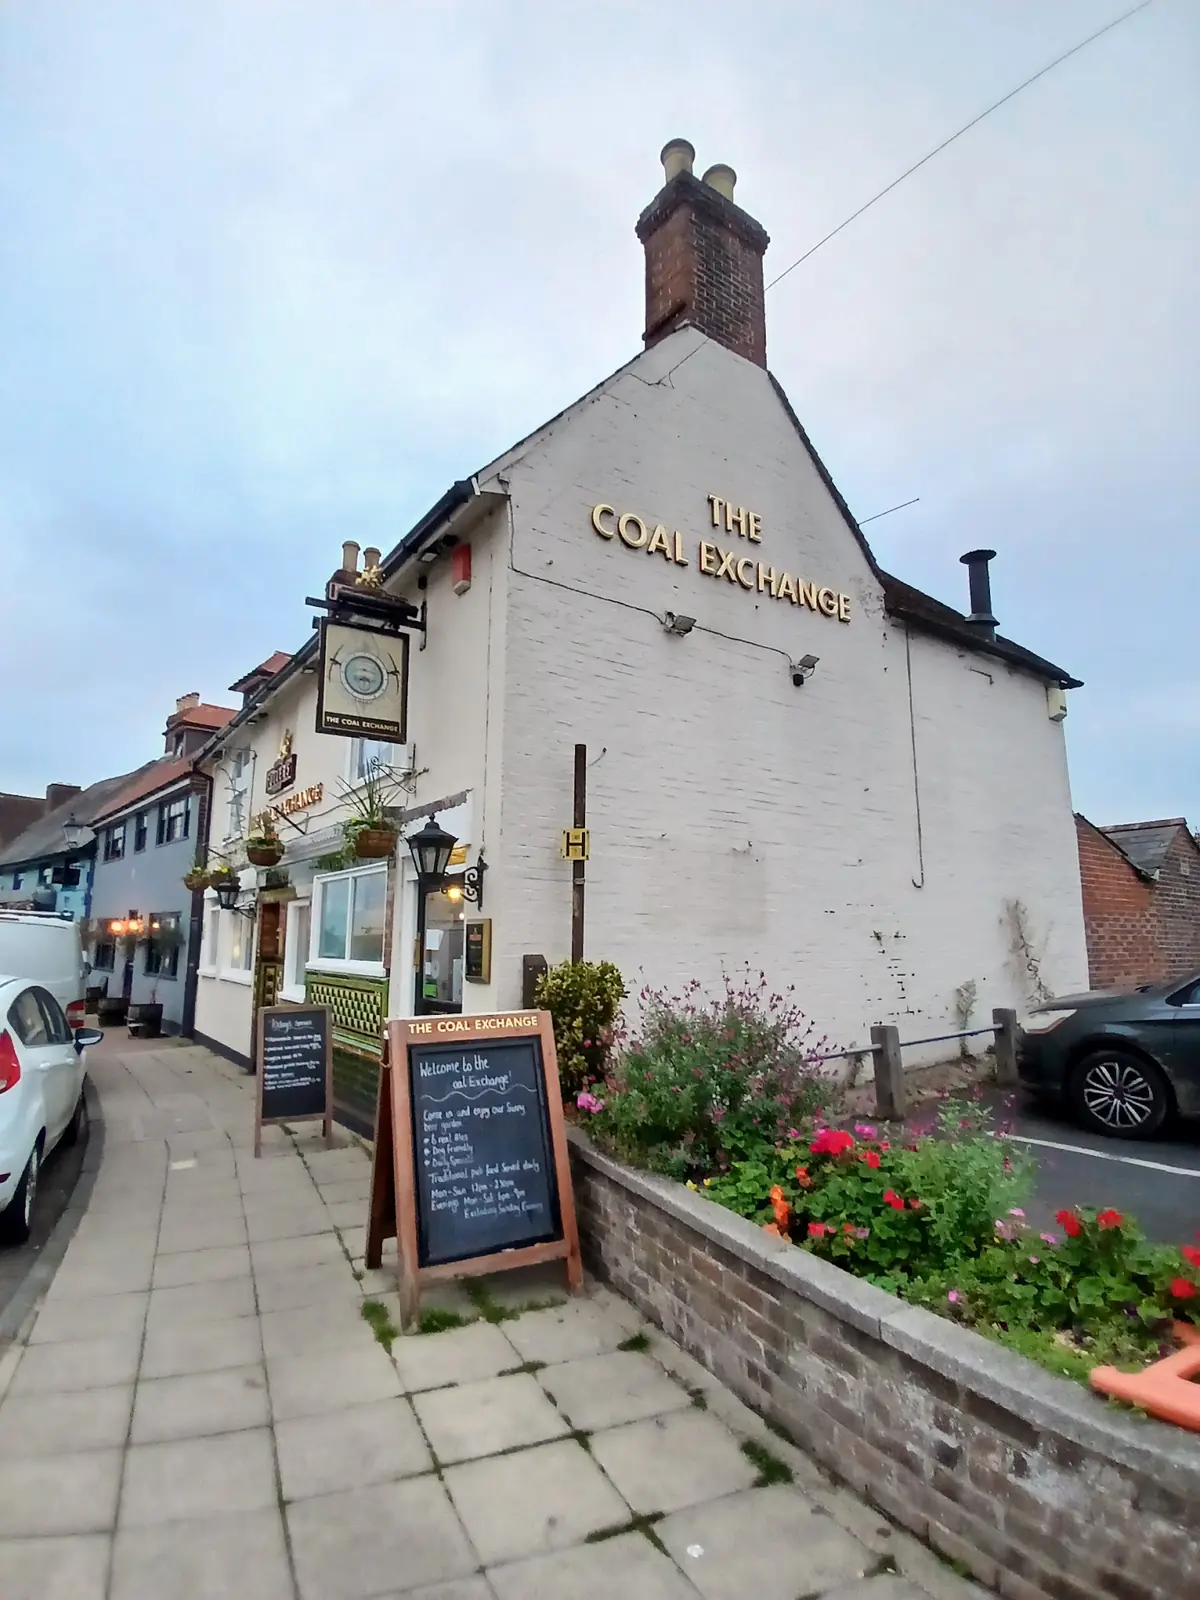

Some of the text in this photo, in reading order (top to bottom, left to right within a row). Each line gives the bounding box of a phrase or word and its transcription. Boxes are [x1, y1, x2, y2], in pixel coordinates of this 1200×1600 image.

[707, 494, 762, 543] THE
[591, 504, 852, 623] COAL EXCHANGE
[326, 715, 399, 732] THE COAL EXCHANGE
[566, 832, 586, 857] H
[408, 1016, 538, 1034] THE COAL EXCHANGE
[419, 1054, 490, 1077] Welcome to the
[423, 1110, 442, 1121] Come
[456, 1106, 470, 1117] and
